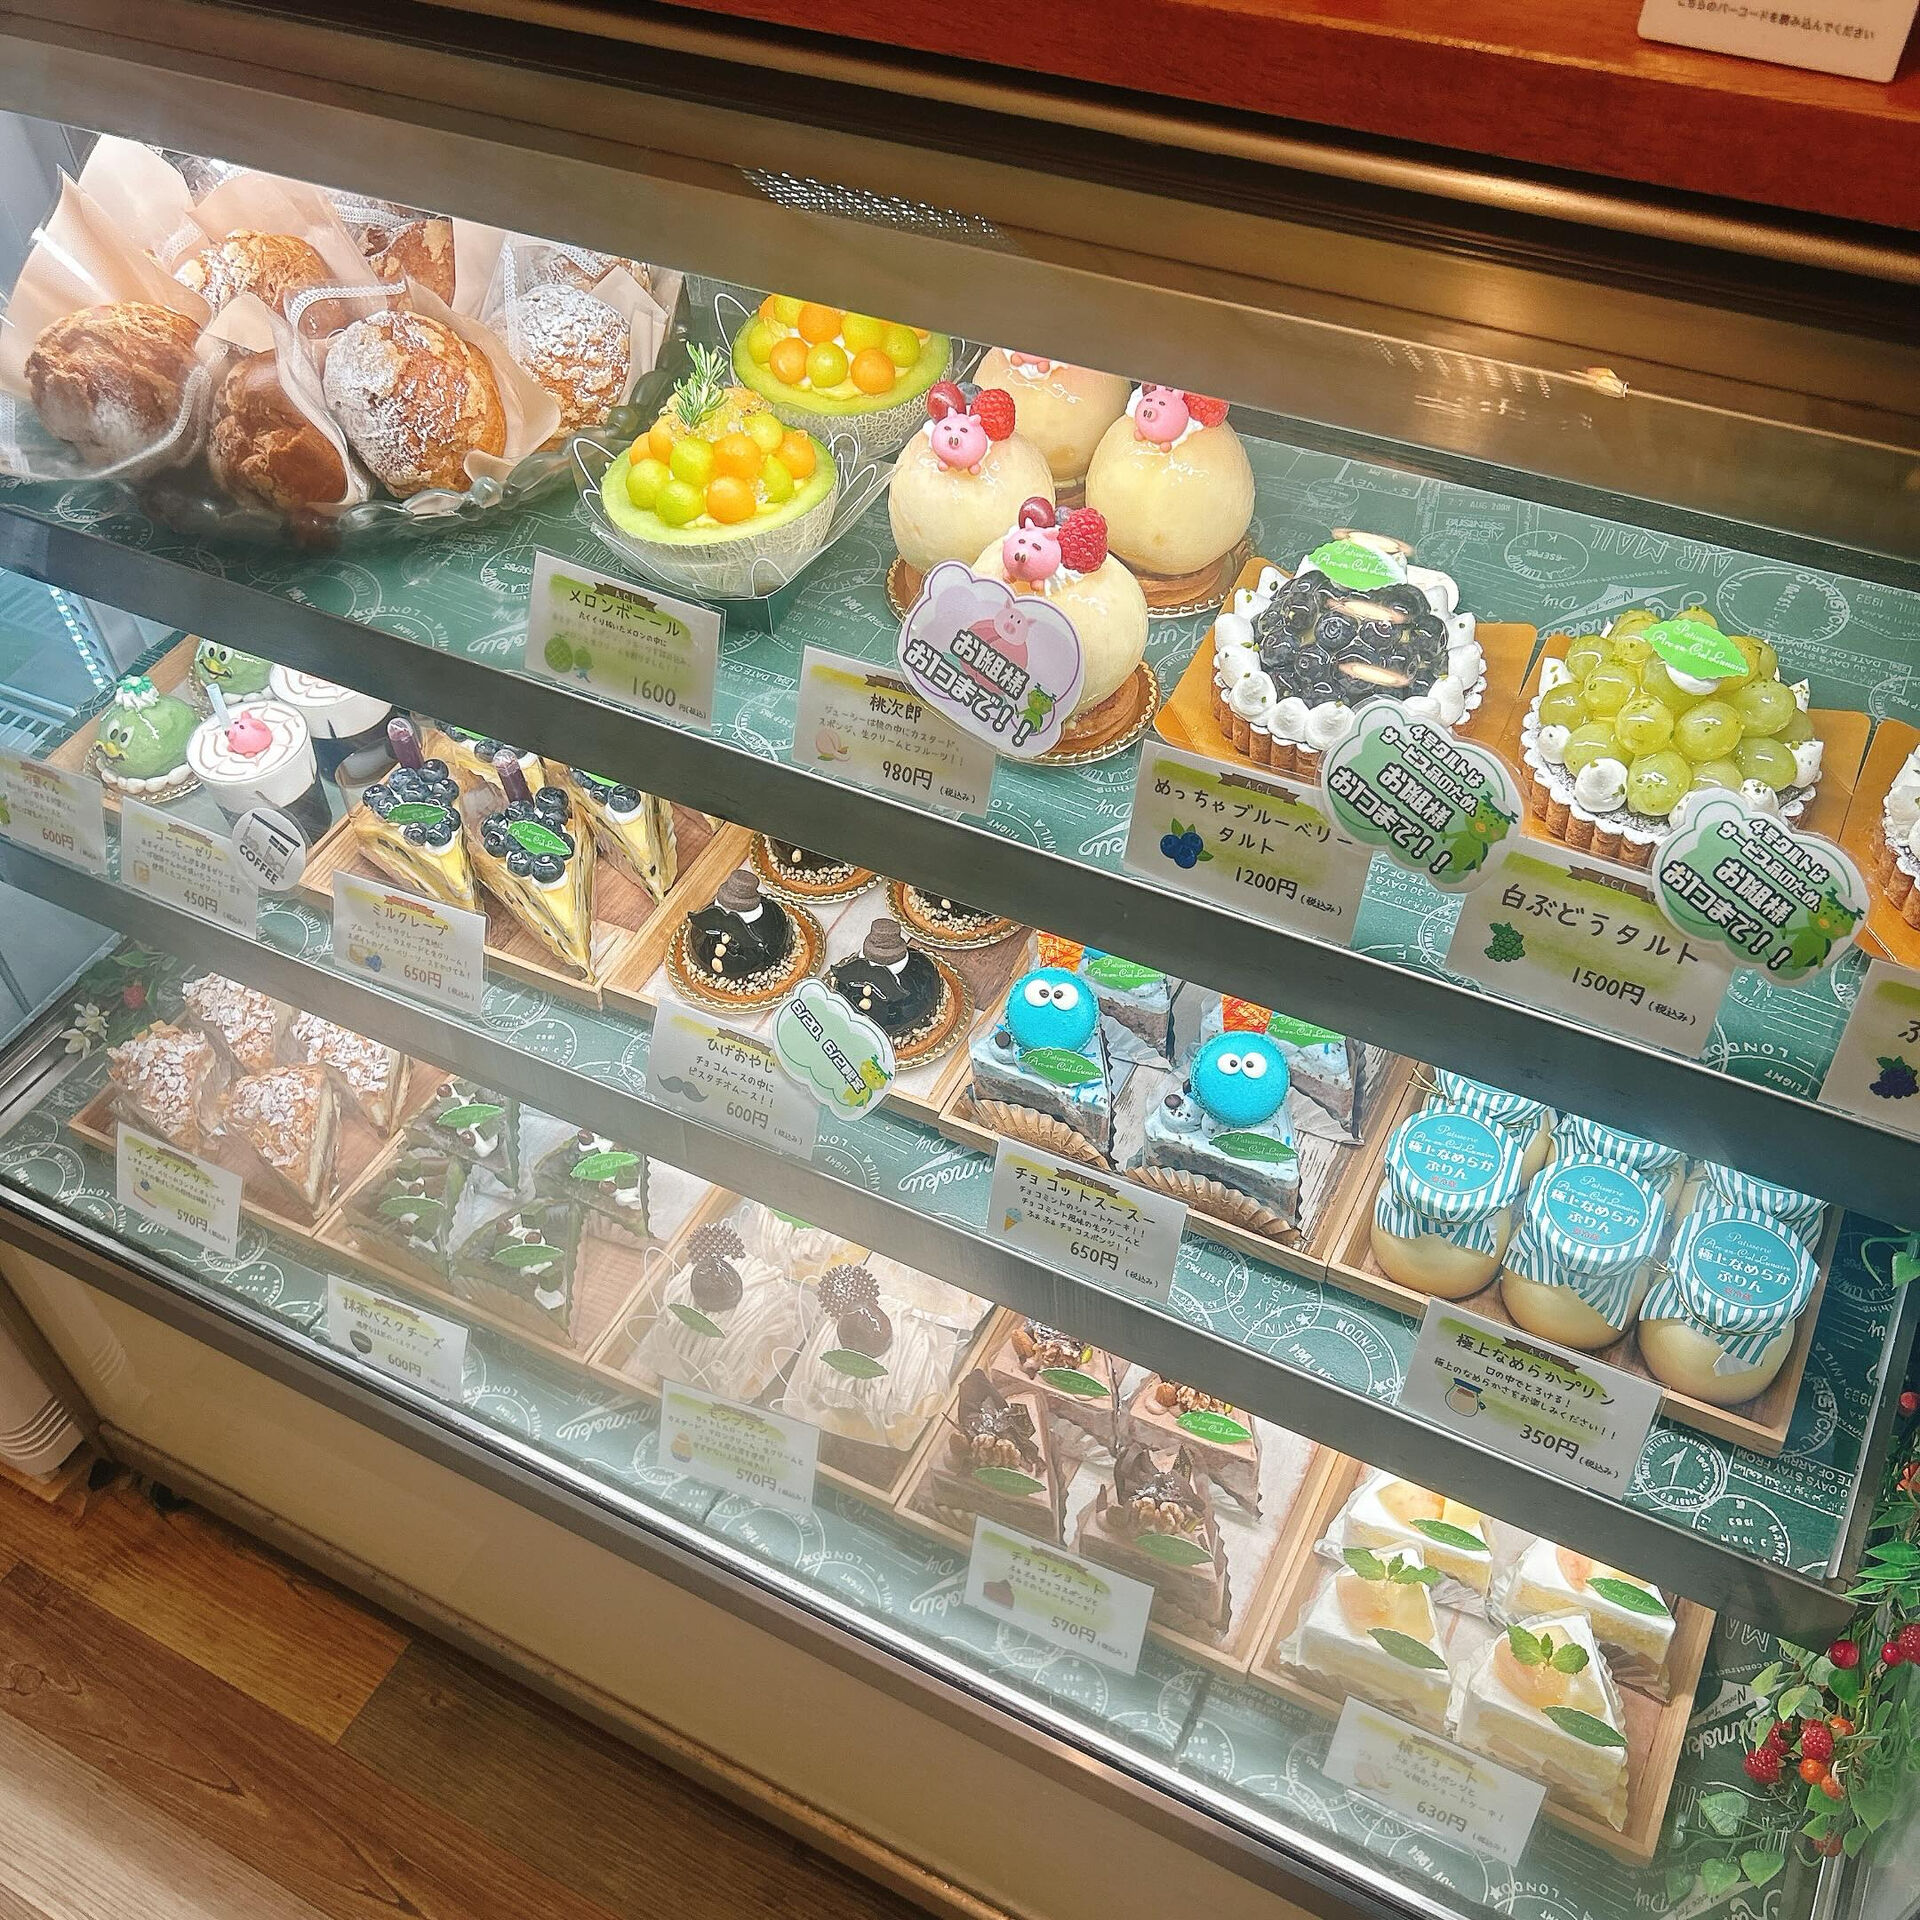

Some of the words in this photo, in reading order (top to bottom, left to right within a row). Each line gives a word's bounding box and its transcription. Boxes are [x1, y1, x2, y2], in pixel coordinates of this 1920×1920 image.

[1591, 523, 1669, 564] MAIL
[1600, 571, 1657, 583] construct
[1676, 546, 1733, 578] AIR
[1785, 647, 1816, 660] STAY
[1817, 654, 1849, 669] DAYS
[1831, 650, 1847, 660] OF
[1851, 653, 1882, 668] DATE
[633, 676, 677, 708] 1600
[869, 692, 923, 724] 桃次郎
[1379, 725, 1478, 817] サービス品のため、
[1409, 723, 1485, 788] 4号タルトは
[882, 760, 934, 791] 980円
[1154, 777, 1353, 845] めっちゃブルーベリー
[42, 827, 74, 852] 600円
[155, 829, 223, 861] コーヒーゼリー
[986, 818, 1020, 840] FLIGHT
[1218, 826, 1276, 855] タルト
[239, 844, 280, 886] COFFEE
[1717, 820, 1823, 913] サービス品のため、
[1749, 818, 1830, 885] 4号タルトは
[1235, 866, 1298, 900] 1200円
[1300, 895, 1343, 917] (税込み)
[1375, 876, 1408, 892] DAYS
[183, 888, 218, 914] 450円
[372, 902, 449, 936] ミルクレープ
[1501, 883, 1699, 965] 白ぶどうタルト
[403, 964, 442, 990] 650円
[1572, 966, 1646, 1006] 1500円
[1648, 1001, 1696, 1026] (税込み)
[706, 1037, 776, 1074] ひげおやじ
[695, 1055, 775, 1094] チョコムースの中に
[1764, 1068, 1809, 1096] FLIGHT
[726, 1101, 769, 1130] 600円
[824, 1155, 852, 1176] FLIGHT
[1014, 1166, 1156, 1225] チョコットスースー
[1018, 1185, 1146, 1238] チョコミントのショートケーキ！！
[177, 1208, 208, 1233] 570円
[1021, 1196, 1141, 1248] チョコミント風味の生クリームと
[1069, 1240, 1119, 1271] 650円
[387, 1353, 423, 1378] 600円
[1455, 1332, 1616, 1406] 極上なめらかプリン
[1485, 1365, 1571, 1408] 口の中でとろける！
[1519, 1423, 1580, 1460] 350円
[735, 1468, 778, 1493] 570円
[1010, 1552, 1104, 1595] チョコショート
[1050, 1615, 1097, 1644] 570円
[1397, 1739, 1478, 1784] 桃ショート
[1416, 1800, 1468, 1833] 630円
